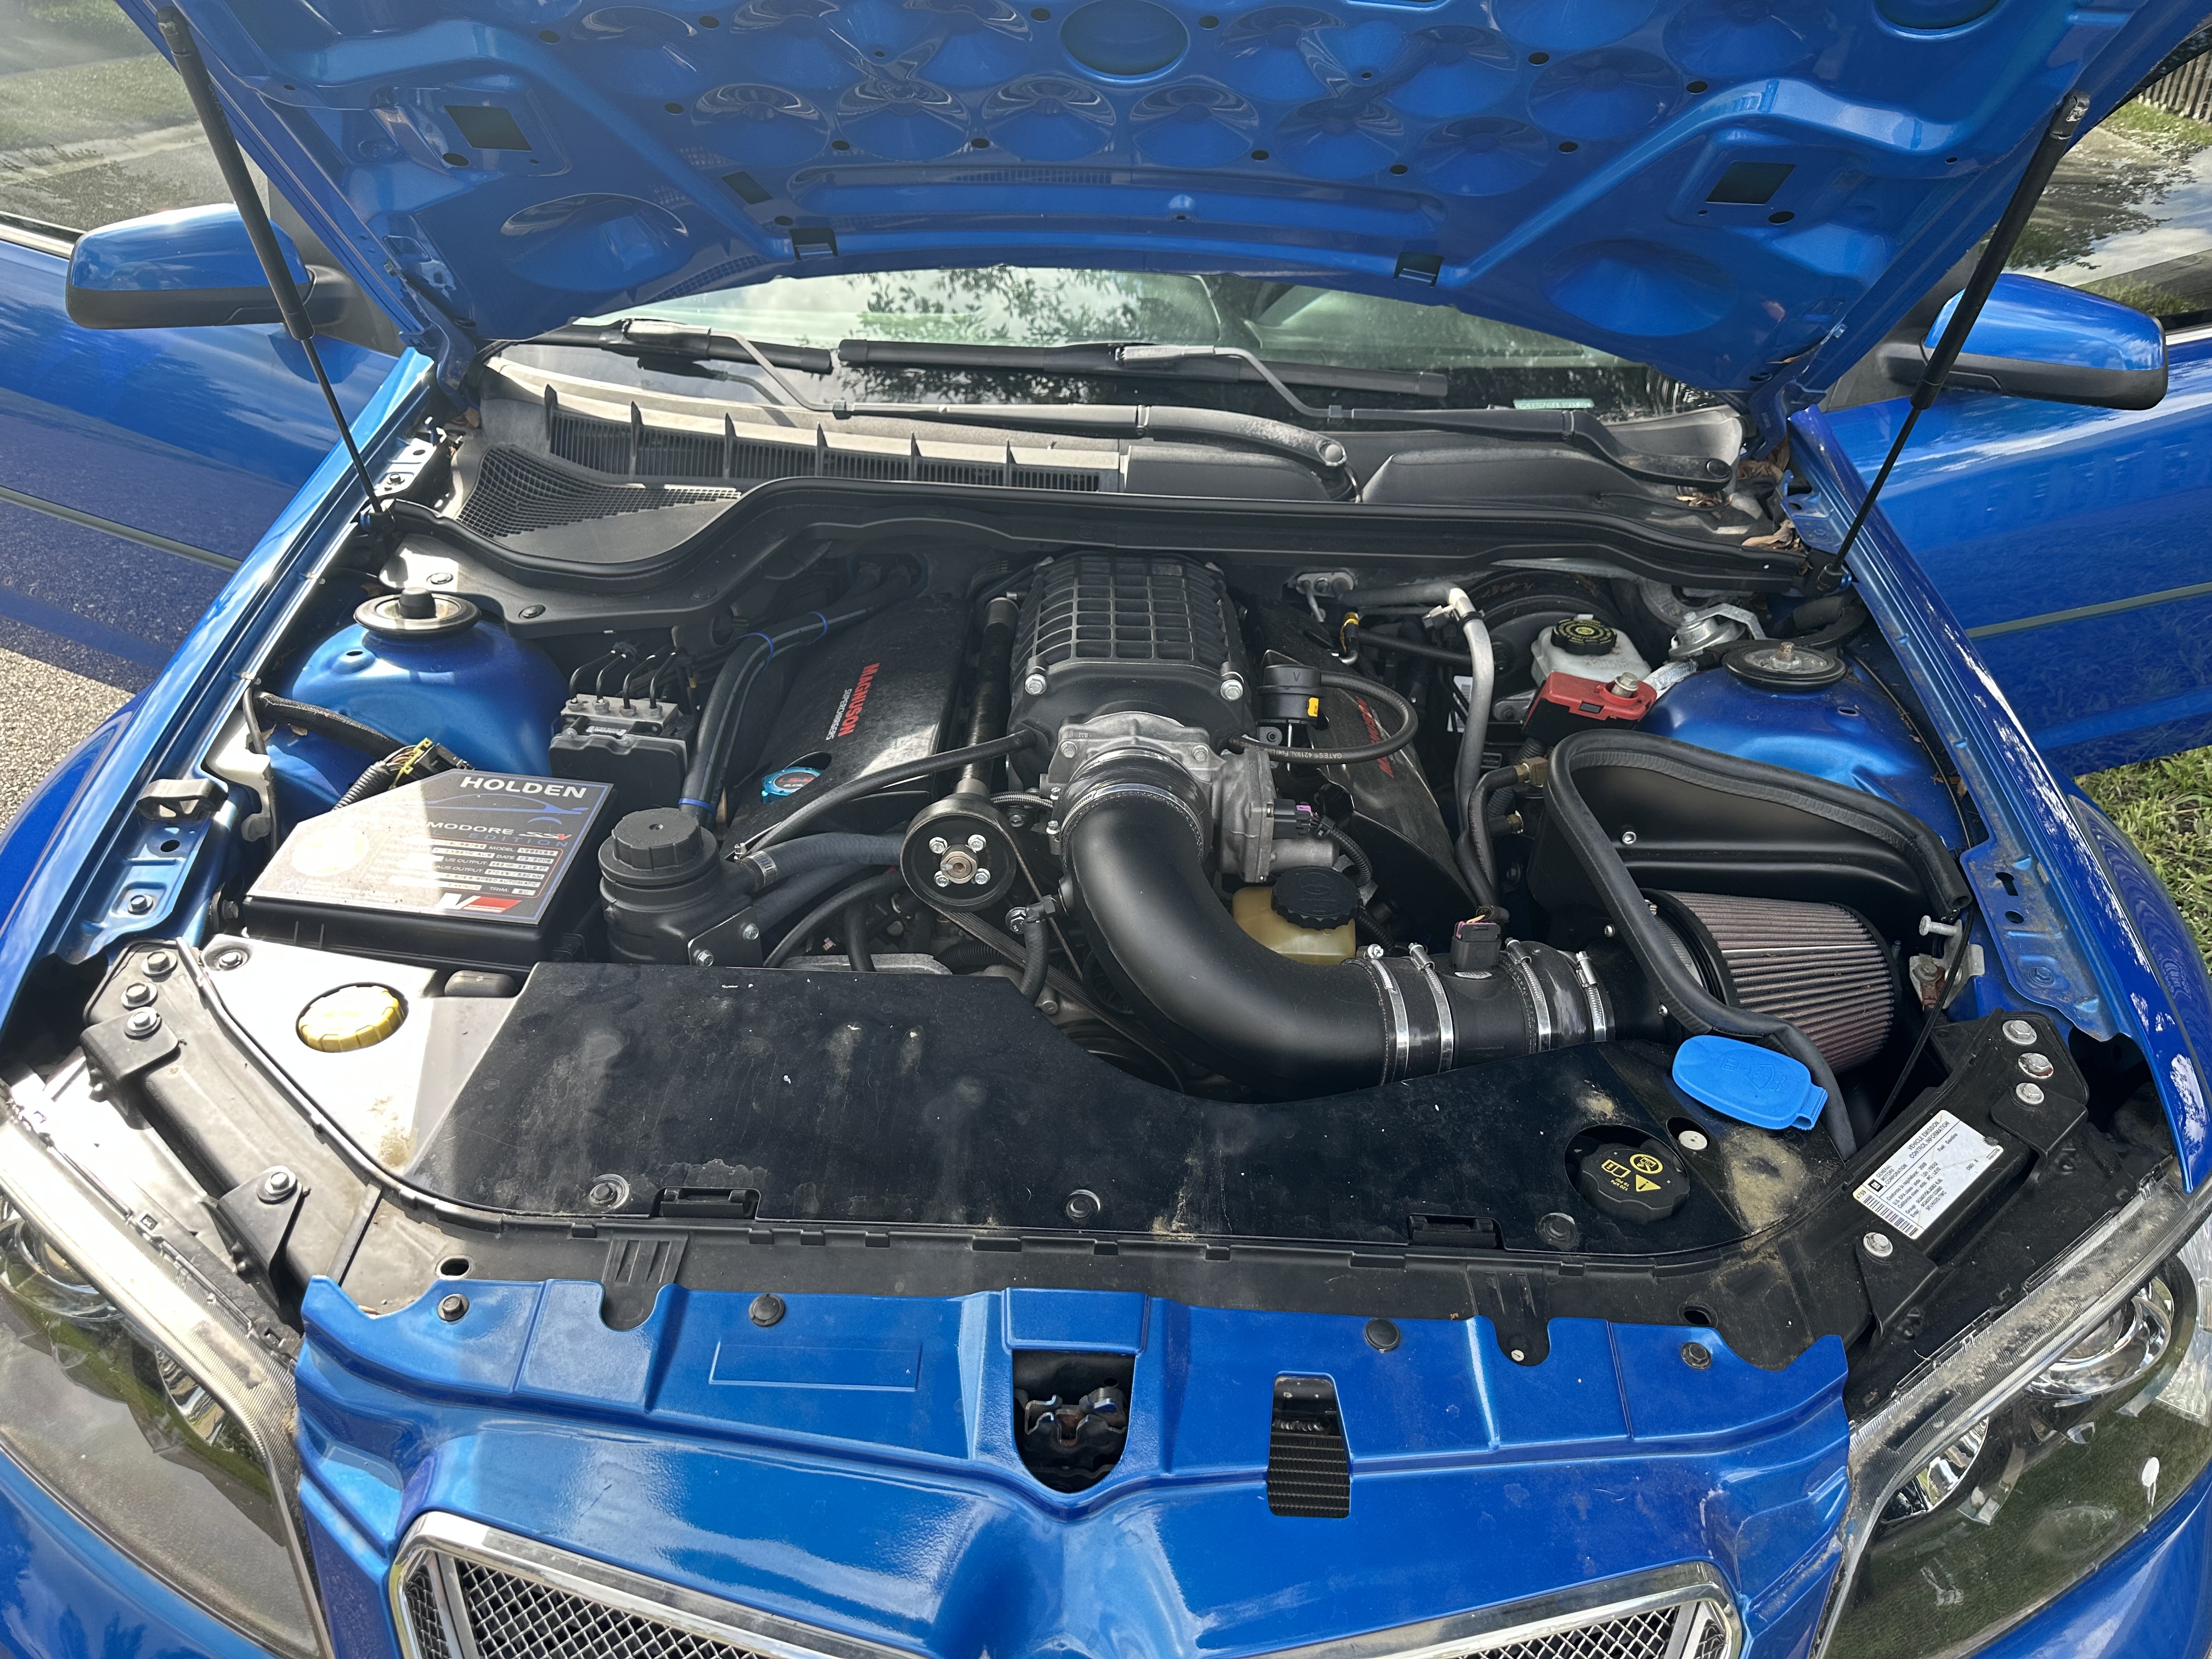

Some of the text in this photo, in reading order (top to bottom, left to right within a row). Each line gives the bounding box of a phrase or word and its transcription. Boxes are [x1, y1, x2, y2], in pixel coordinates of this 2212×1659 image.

[838, 663, 880, 736] MAGNUSON
[826, 689, 853, 740] SUPERCHARGERS
[1356, 695, 1395, 778] MNUSON
[460, 776, 587, 798] HOLDEN
[468, 833, 568, 847] EDITION
[1908, 1121, 1939, 1150] VEHICLE EMISSION
[1909, 1121, 1949, 1158] CONTROL INFORMATION
[1876, 1164, 1891, 1177] GENERAL
[1880, 1168, 1894, 1181] MOTORS
[1885, 1164, 1907, 1184] CORPORATION
[1855, 1189, 1866, 1199] 4759
